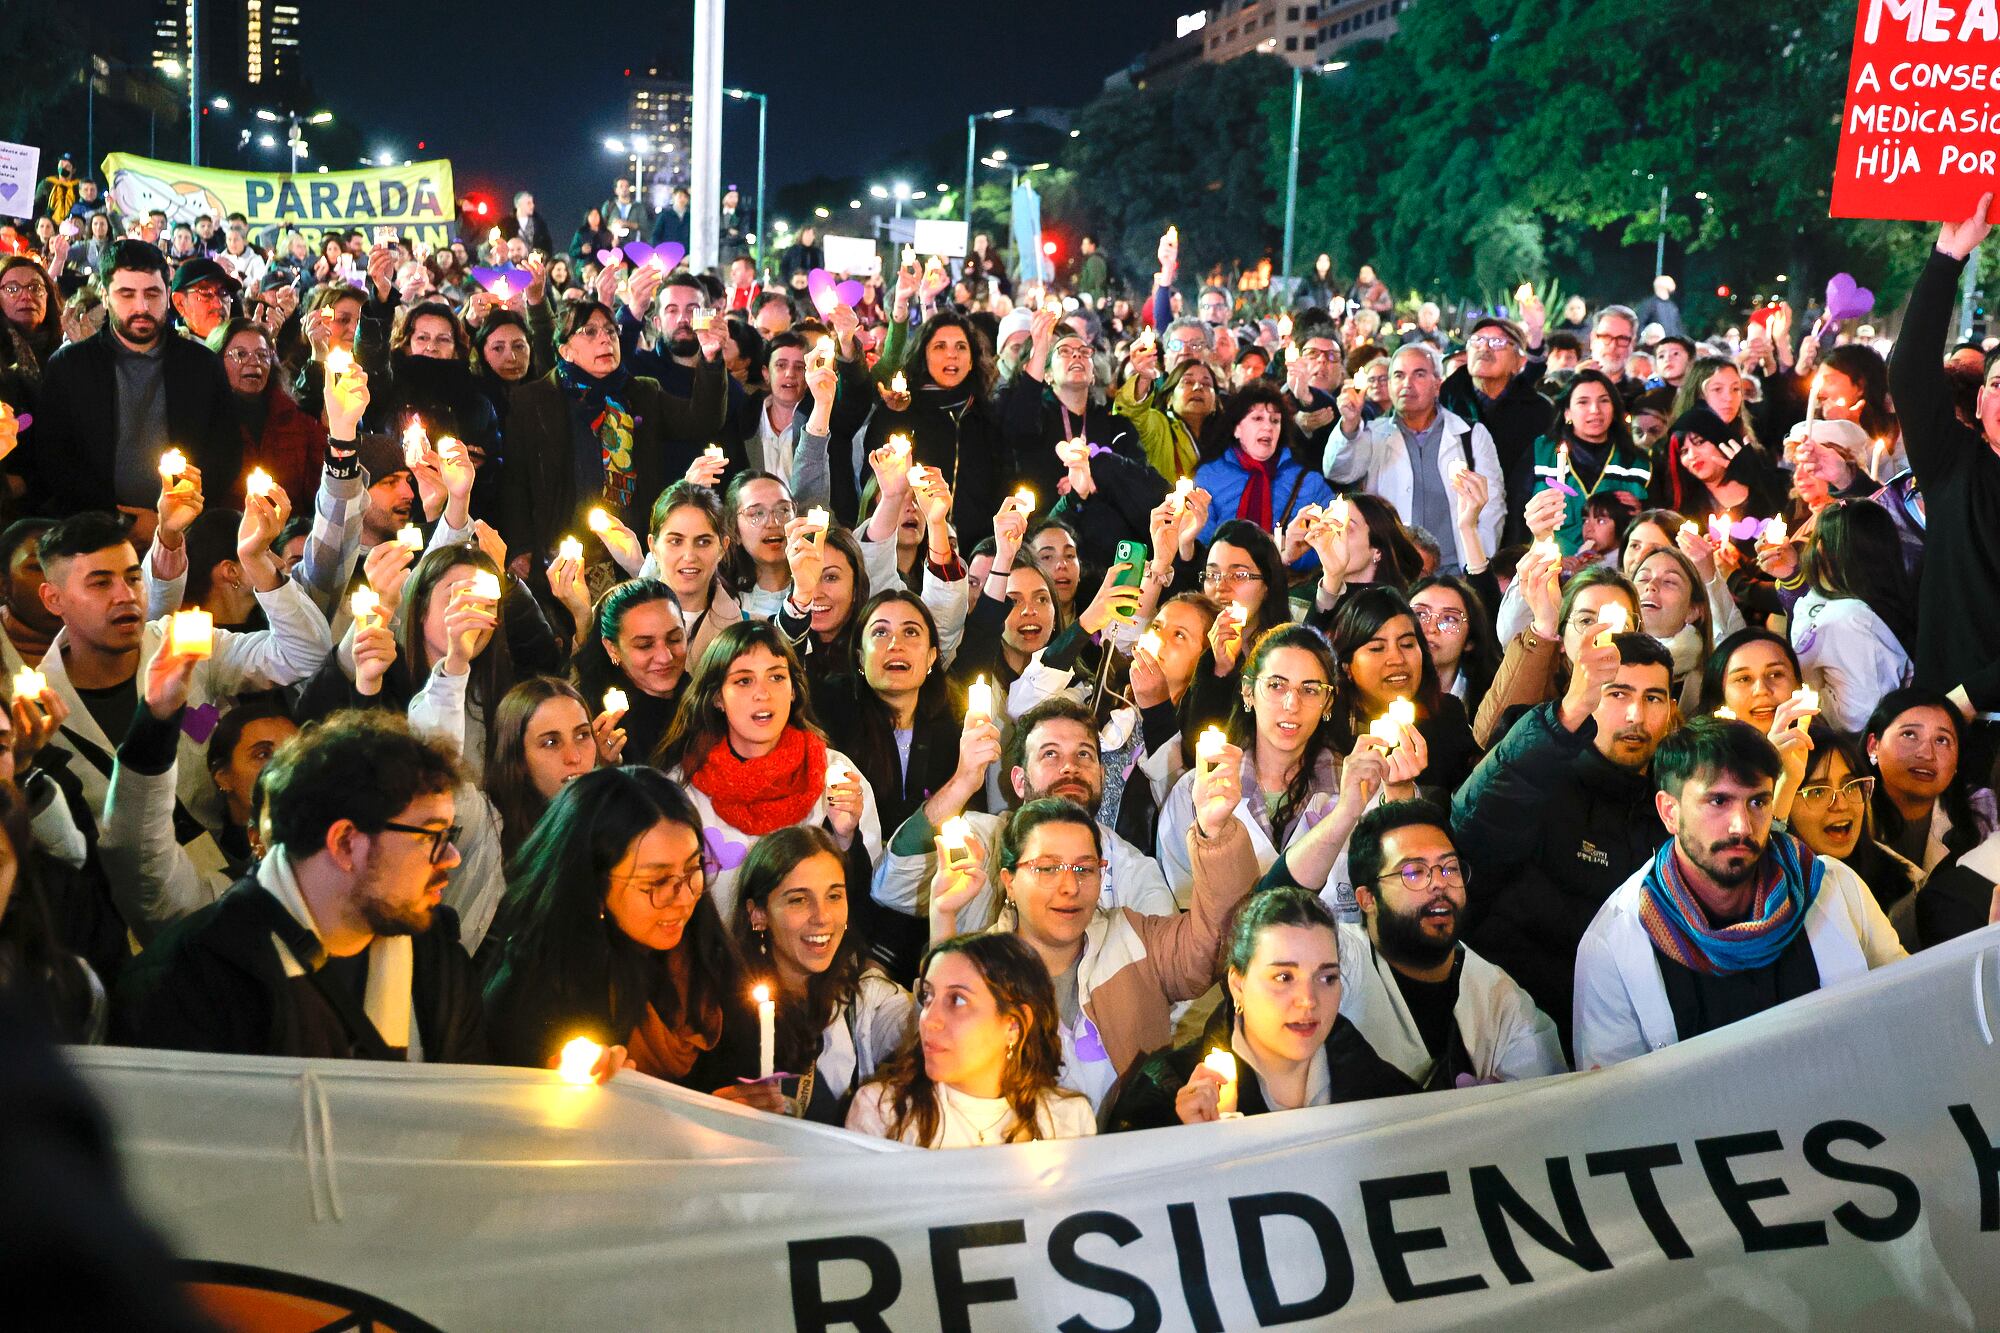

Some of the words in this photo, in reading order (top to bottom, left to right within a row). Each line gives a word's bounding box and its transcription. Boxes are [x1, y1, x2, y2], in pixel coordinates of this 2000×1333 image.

[1864, 0, 2000, 44] MEA
[1855, 62, 1881, 93] A
[245, 178, 443, 219] PARADA
[787, 1119, 1922, 1333] RESIDENTES
